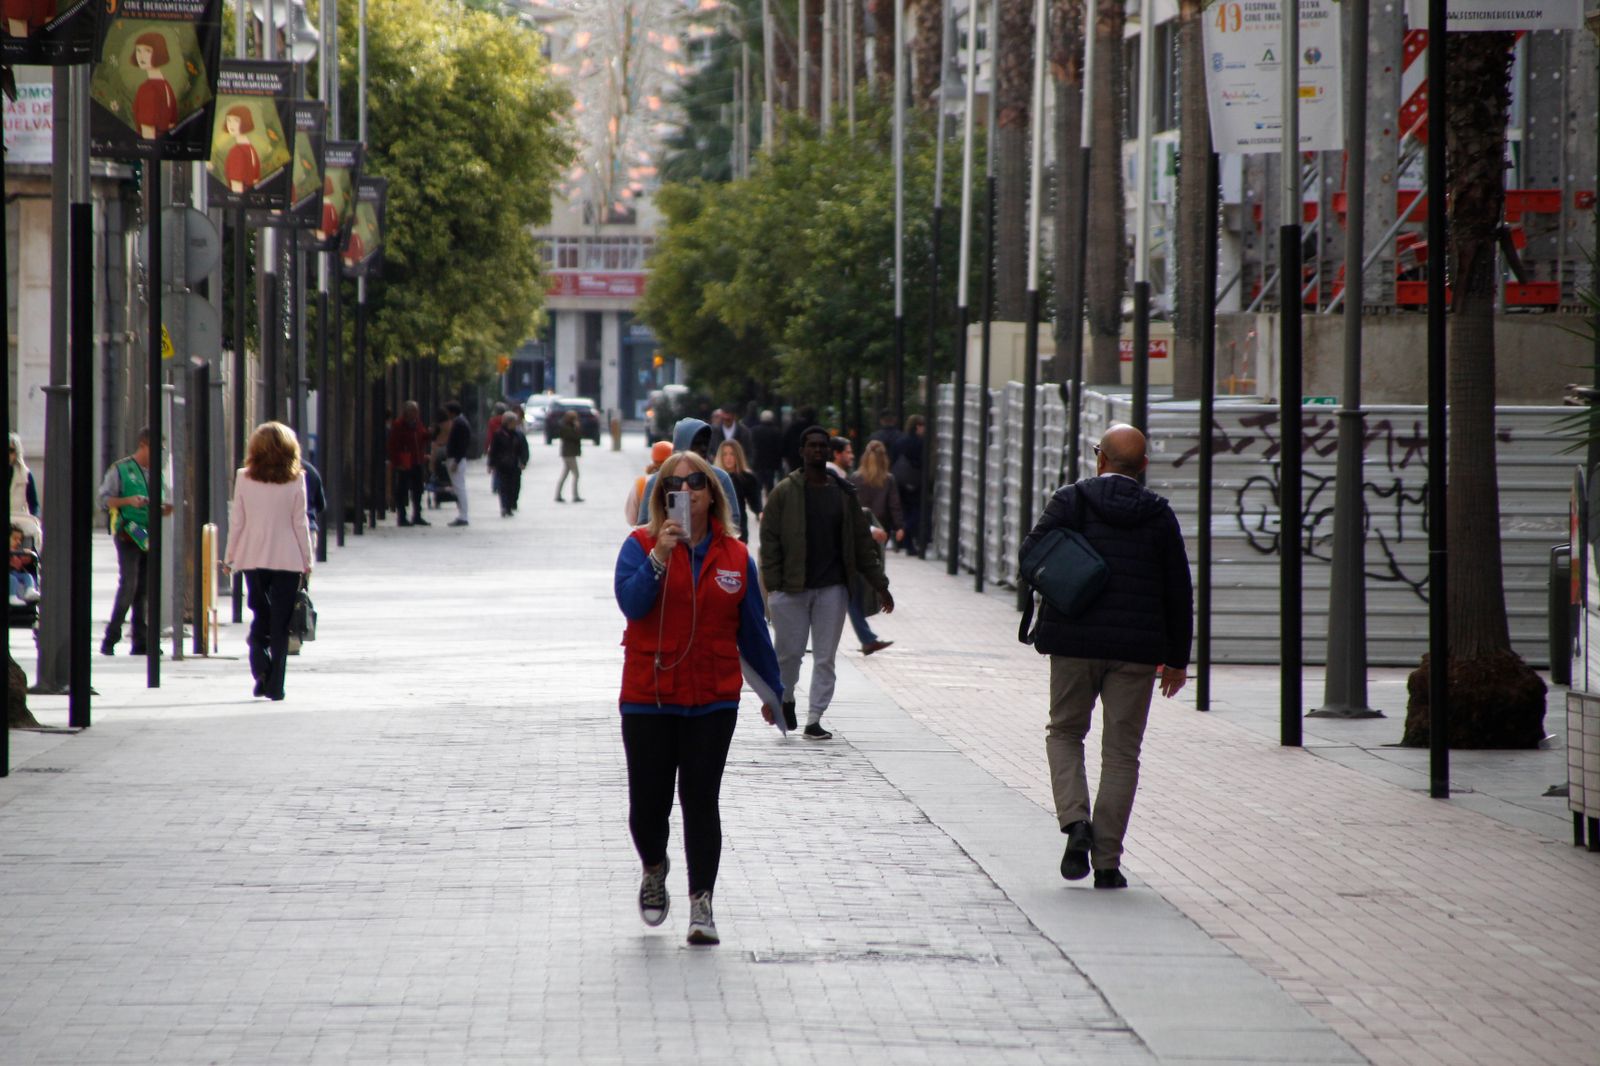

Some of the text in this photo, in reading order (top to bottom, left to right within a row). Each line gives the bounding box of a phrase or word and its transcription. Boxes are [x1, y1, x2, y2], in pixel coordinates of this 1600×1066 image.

[1215, 2, 1242, 33] 49
[31, 101, 51, 115] DE
[3, 118, 52, 131] UELVA
